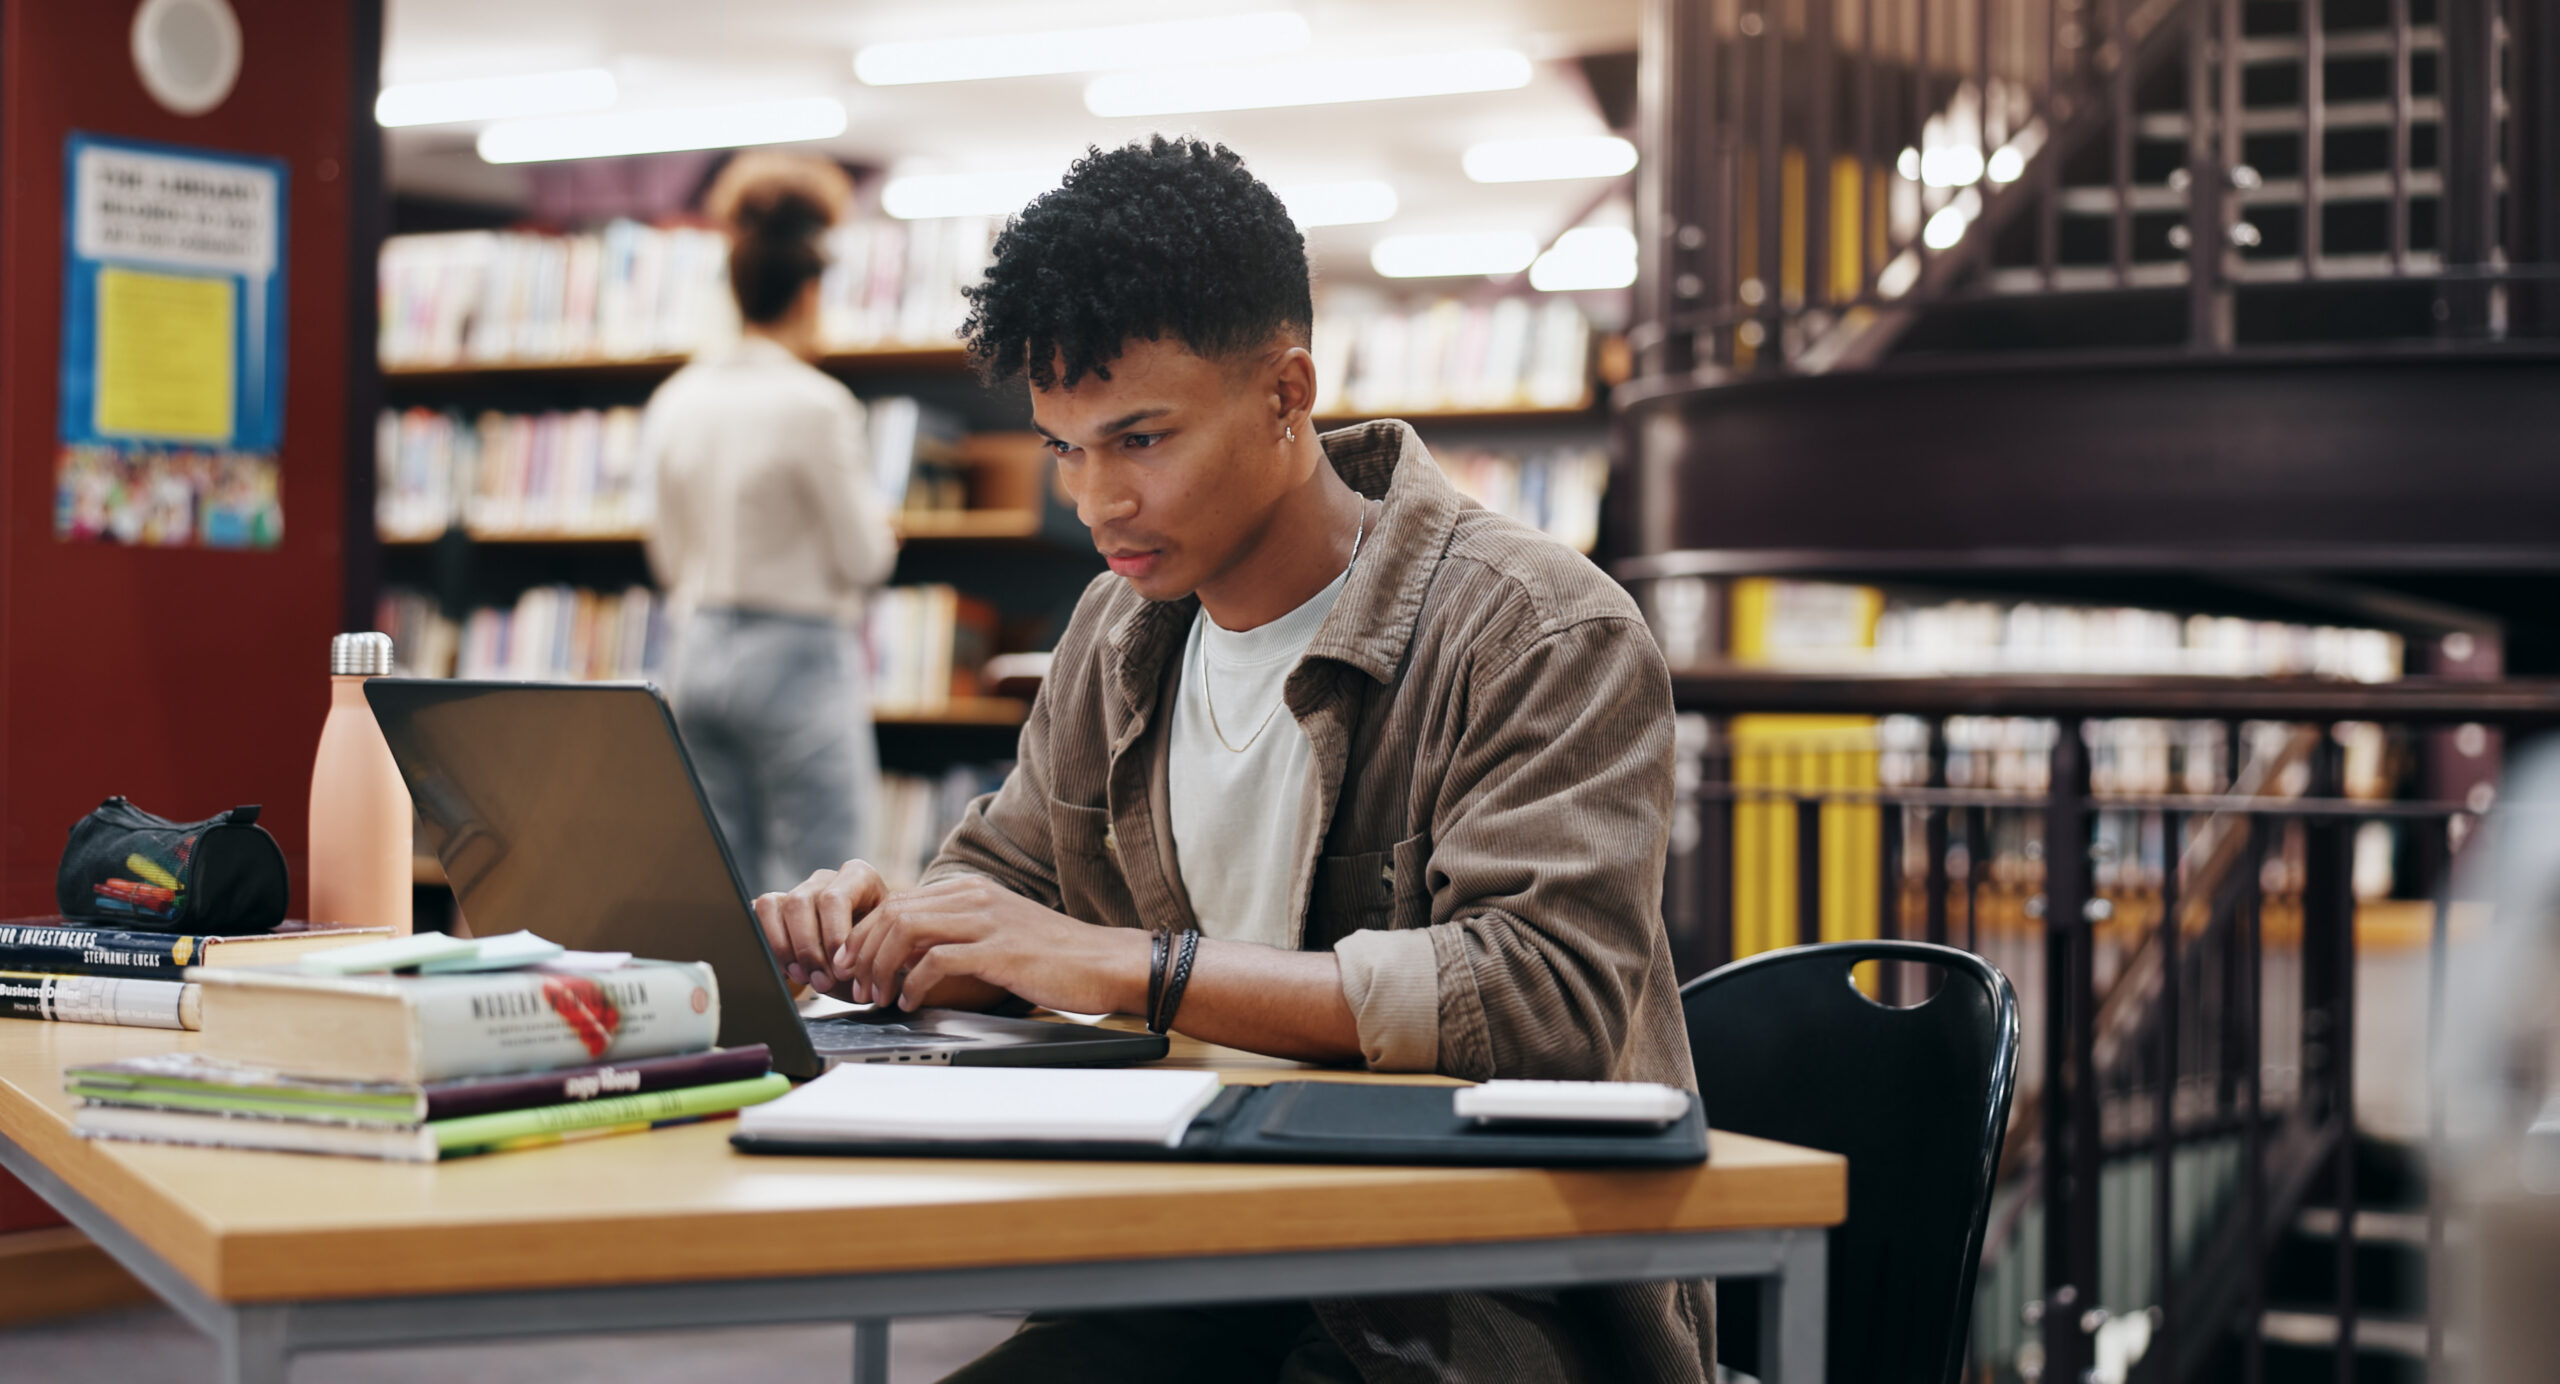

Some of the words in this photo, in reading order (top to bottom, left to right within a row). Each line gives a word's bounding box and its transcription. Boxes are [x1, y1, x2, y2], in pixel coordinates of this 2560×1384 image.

[0, 927, 17, 944] UR
[19, 929, 98, 949] INVESTMENTS
[83, 950, 130, 966] STEPHANIE
[132, 953, 160, 967] LUCAS
[0, 983, 43, 999] Business
[46, 986, 81, 1001] Online
